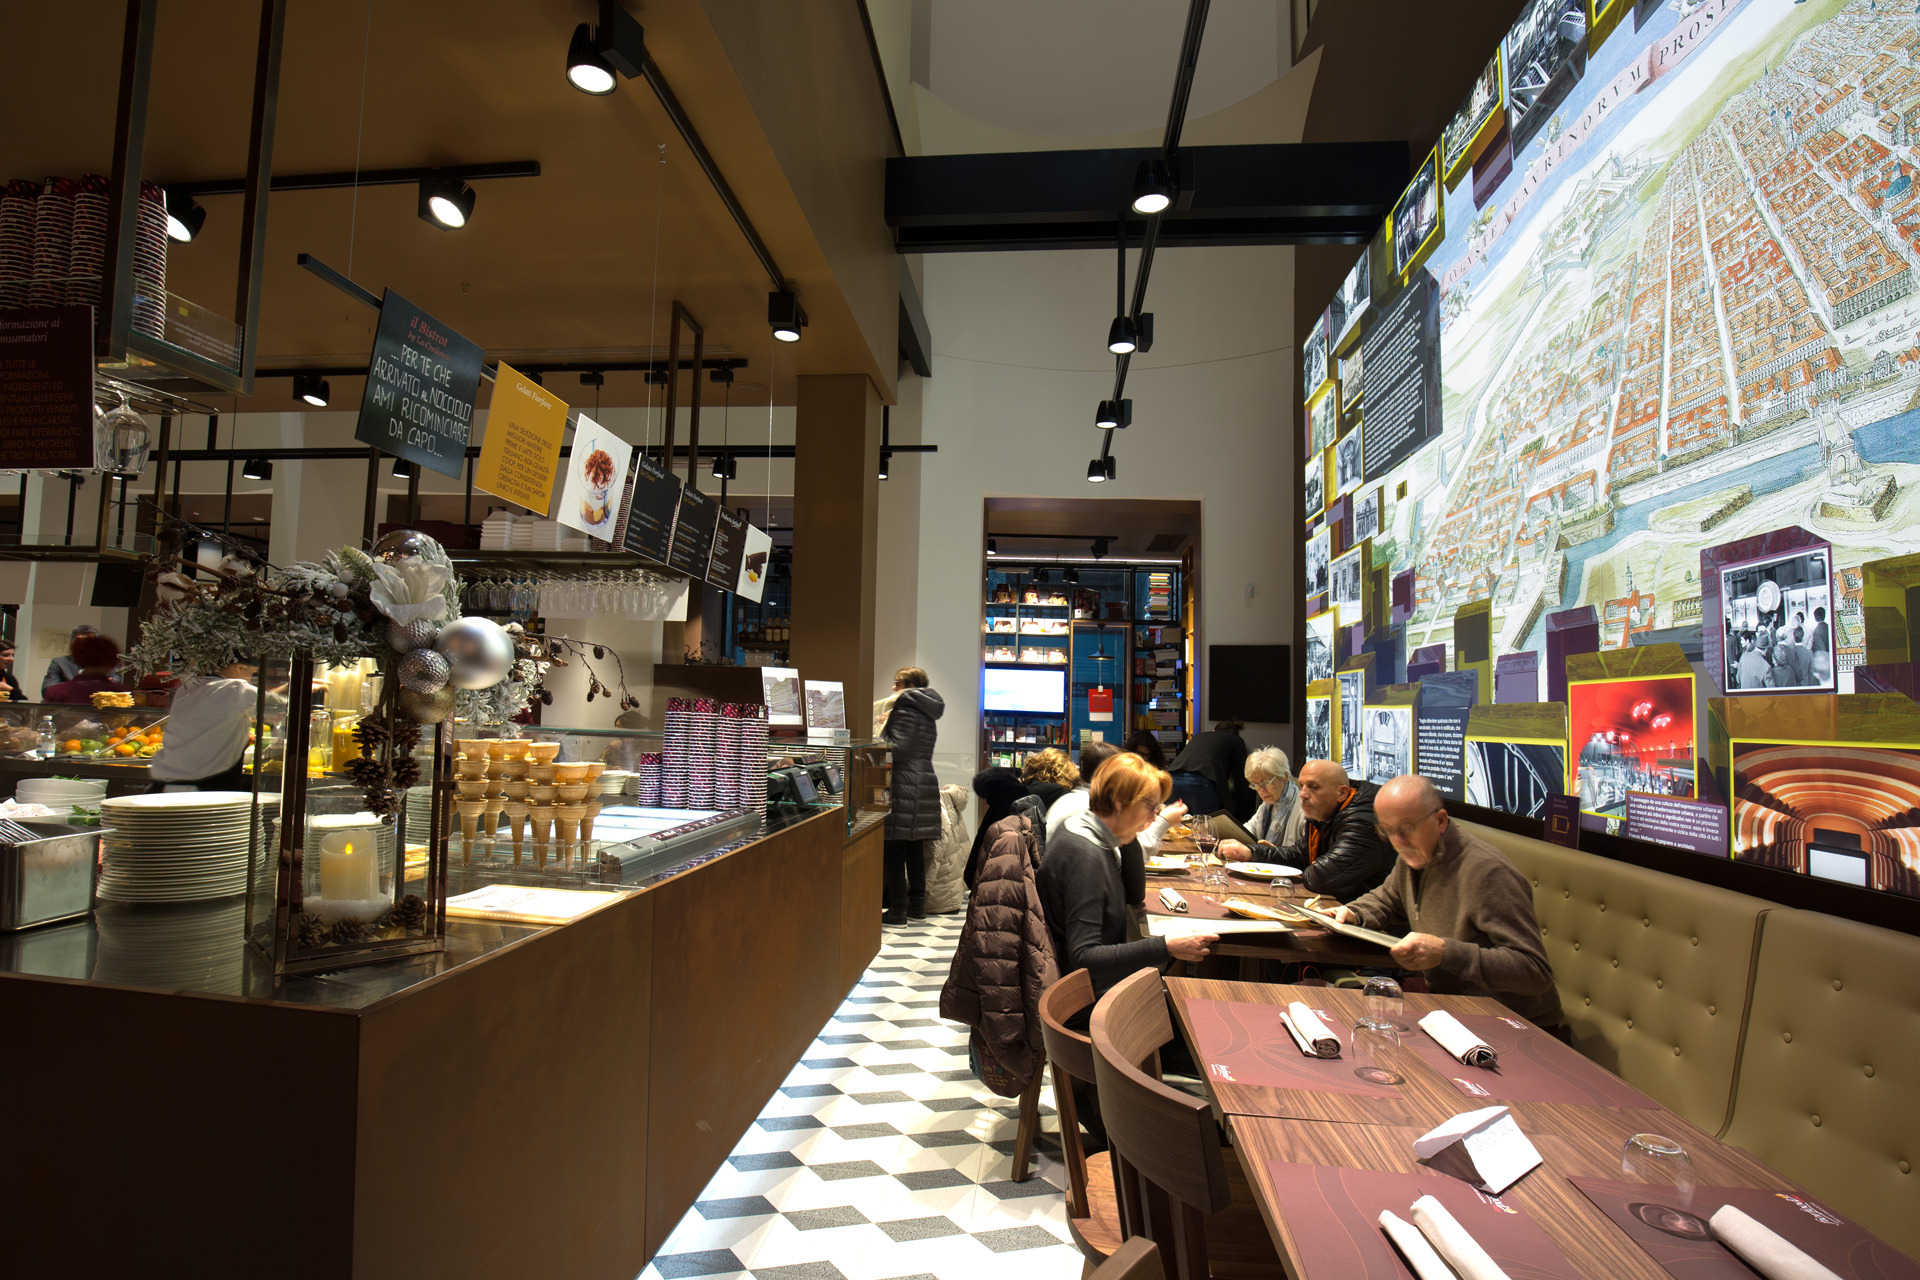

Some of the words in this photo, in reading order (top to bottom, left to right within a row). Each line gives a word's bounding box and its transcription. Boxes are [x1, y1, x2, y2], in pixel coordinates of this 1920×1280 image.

[51, 317, 60, 328] ai
[409, 316, 419, 328] il
[420, 320, 448, 347] Bistrot
[420, 354, 432, 376] TE
[433, 364, 452, 388] CHE
[372, 384, 395, 411] AMI
[373, 356, 420, 398] ARRIVATO
[429, 387, 472, 422] NOCCIOLO
[388, 417, 403, 440] DA
